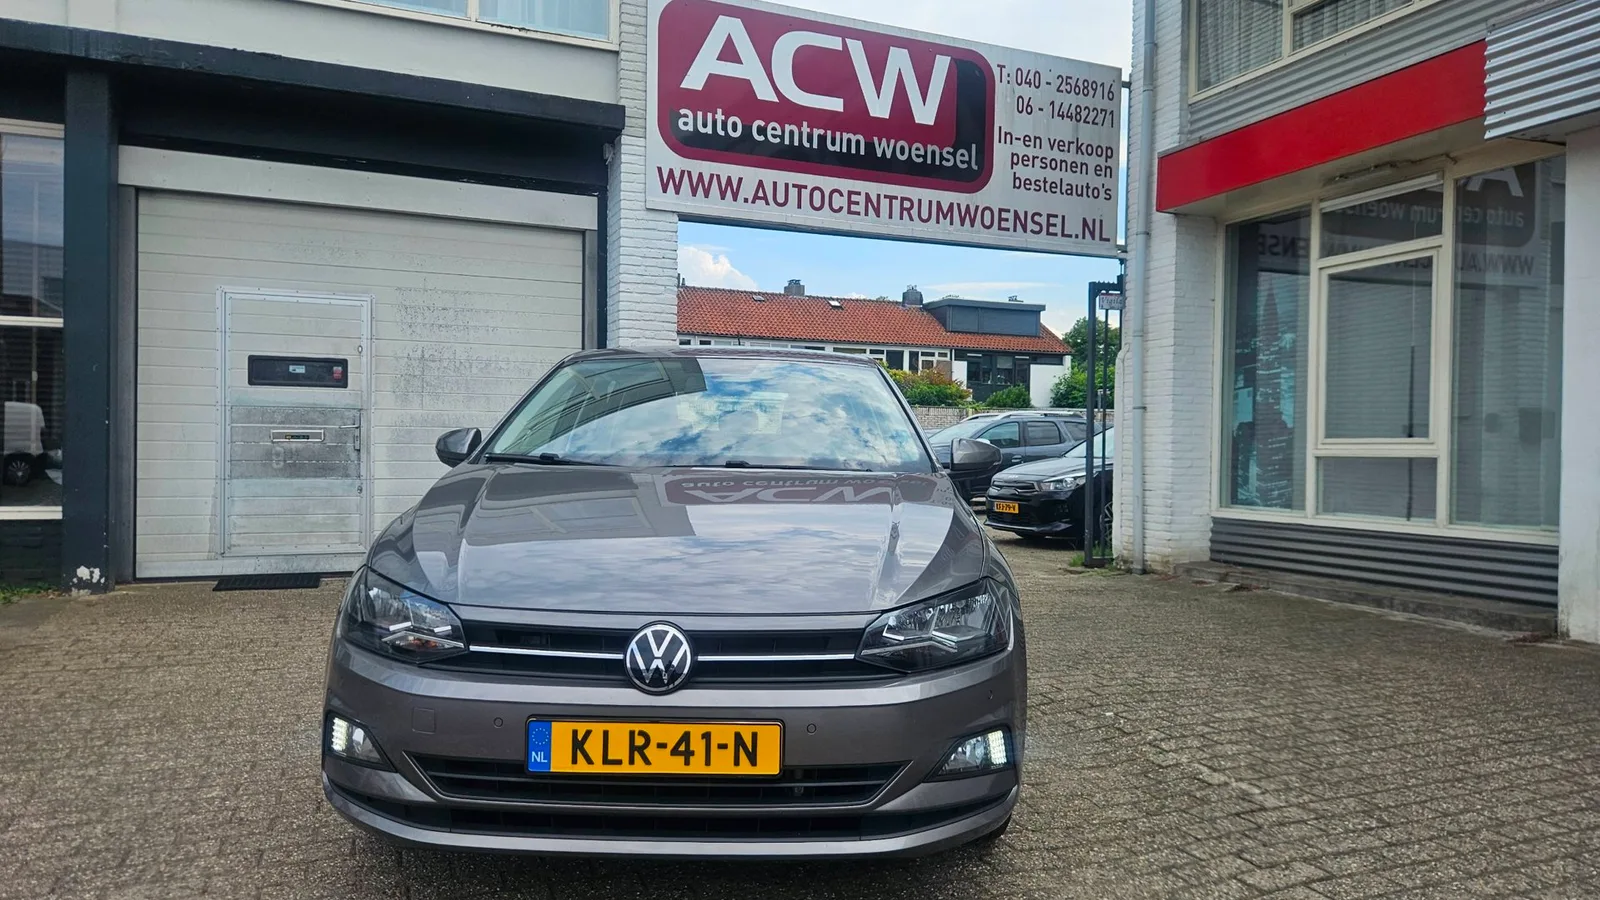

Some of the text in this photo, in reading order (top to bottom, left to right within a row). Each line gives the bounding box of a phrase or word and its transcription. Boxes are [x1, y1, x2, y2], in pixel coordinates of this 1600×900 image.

[680, 14, 952, 126] ACW
[997, 64, 1011, 85] T:
[1015, 67, 1041, 90] 040
[1056, 74, 1115, 101] 2568916
[1016, 95, 1034, 116] 06
[1049, 100, 1115, 128] 14482271
[677, 107, 978, 170] auto centrum woensel
[998, 126, 1114, 163] In-en verkoop
[1010, 152, 1113, 178] personen en
[656, 166, 1111, 242] WWW.AUTOCENTRUMWOENSEL.NL
[1012, 172, 1112, 201] bestelauto's
[531, 751, 548, 763] NL
[571, 729, 758, 767] KLR-41-N
